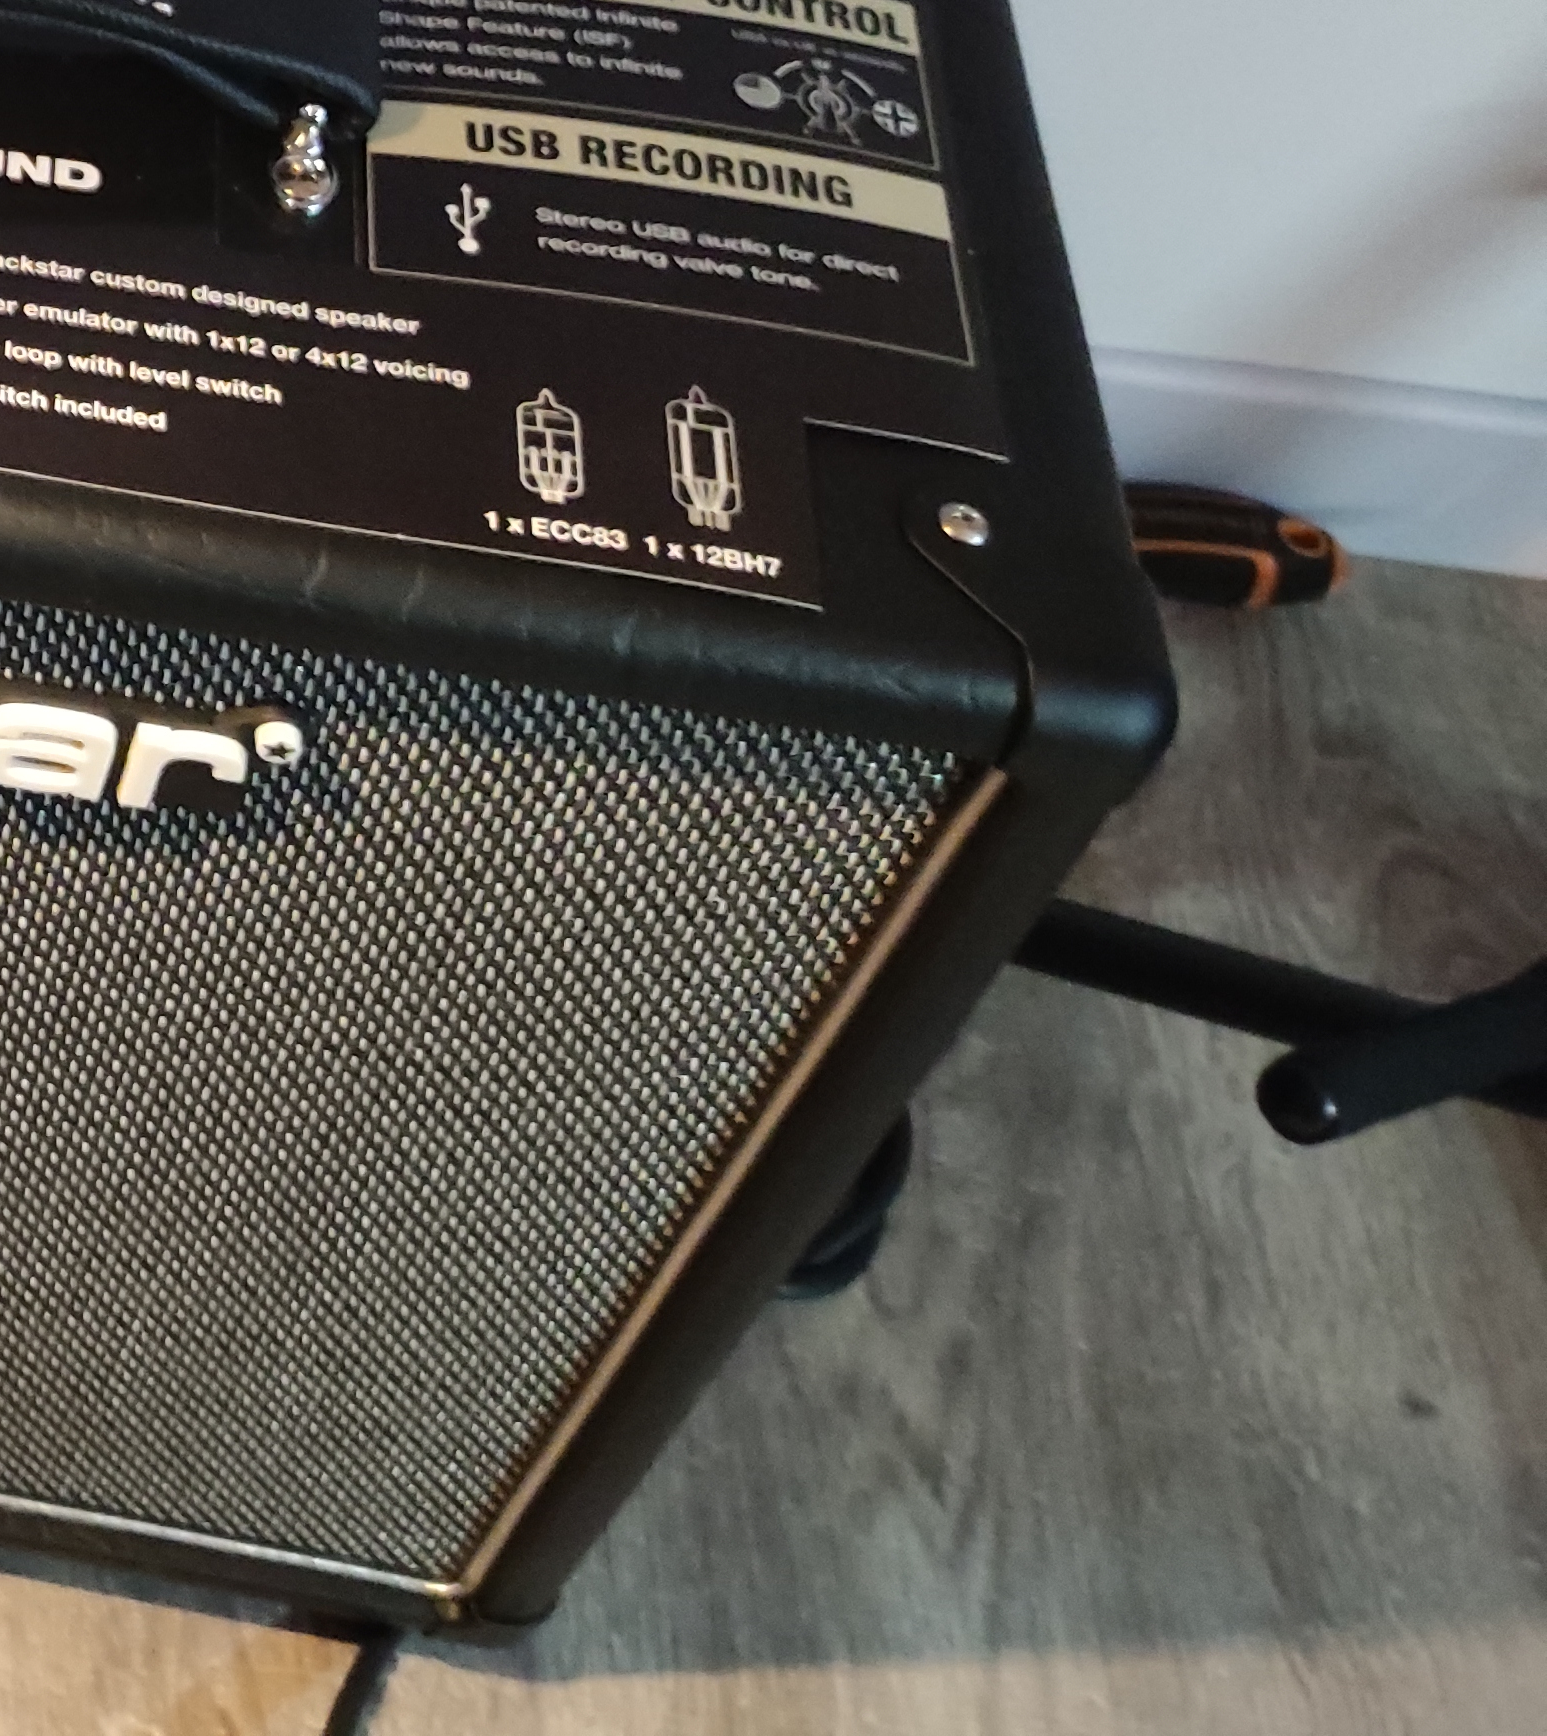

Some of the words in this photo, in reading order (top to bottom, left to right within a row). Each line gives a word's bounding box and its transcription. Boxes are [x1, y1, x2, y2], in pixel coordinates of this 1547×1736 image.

[378, 35, 462, 53] allows
[466, 42, 563, 64] access
[566, 50, 594, 69] to
[378, 59, 437, 76] new
[464, 120, 560, 161] USB
[578, 134, 855, 209] RECORDING
[534, 205, 628, 236] Stereo
[632, 219, 692, 244] USB
[697, 231, 772, 259] audio
[778, 242, 817, 264] for
[822, 251, 901, 284] direct
[537, 235, 669, 271] recording
[674, 253, 744, 280] valve
[90, 268, 188, 301] custom
[191, 284, 311, 322] designed
[314, 304, 423, 337] speaker
[22, 301, 140, 338] emulator
[143, 320, 201, 348] with
[206, 329, 268, 359] 1x12
[270, 342, 302, 364] or
[305, 345, 369, 374] 4x12
[372, 357, 472, 391] voicing
[4, 339, 64, 371] loop
[67, 352, 126, 379] with
[129, 359, 192, 392] level
[194, 373, 285, 407] switch
[53, 392, 169, 434] included
[483, 510, 501, 533] 1
[506, 516, 525, 536] x
[529, 515, 631, 552] ECC83
[643, 534, 660, 558] 1
[666, 541, 685, 561] x
[690, 542, 783, 579] 12BH7
